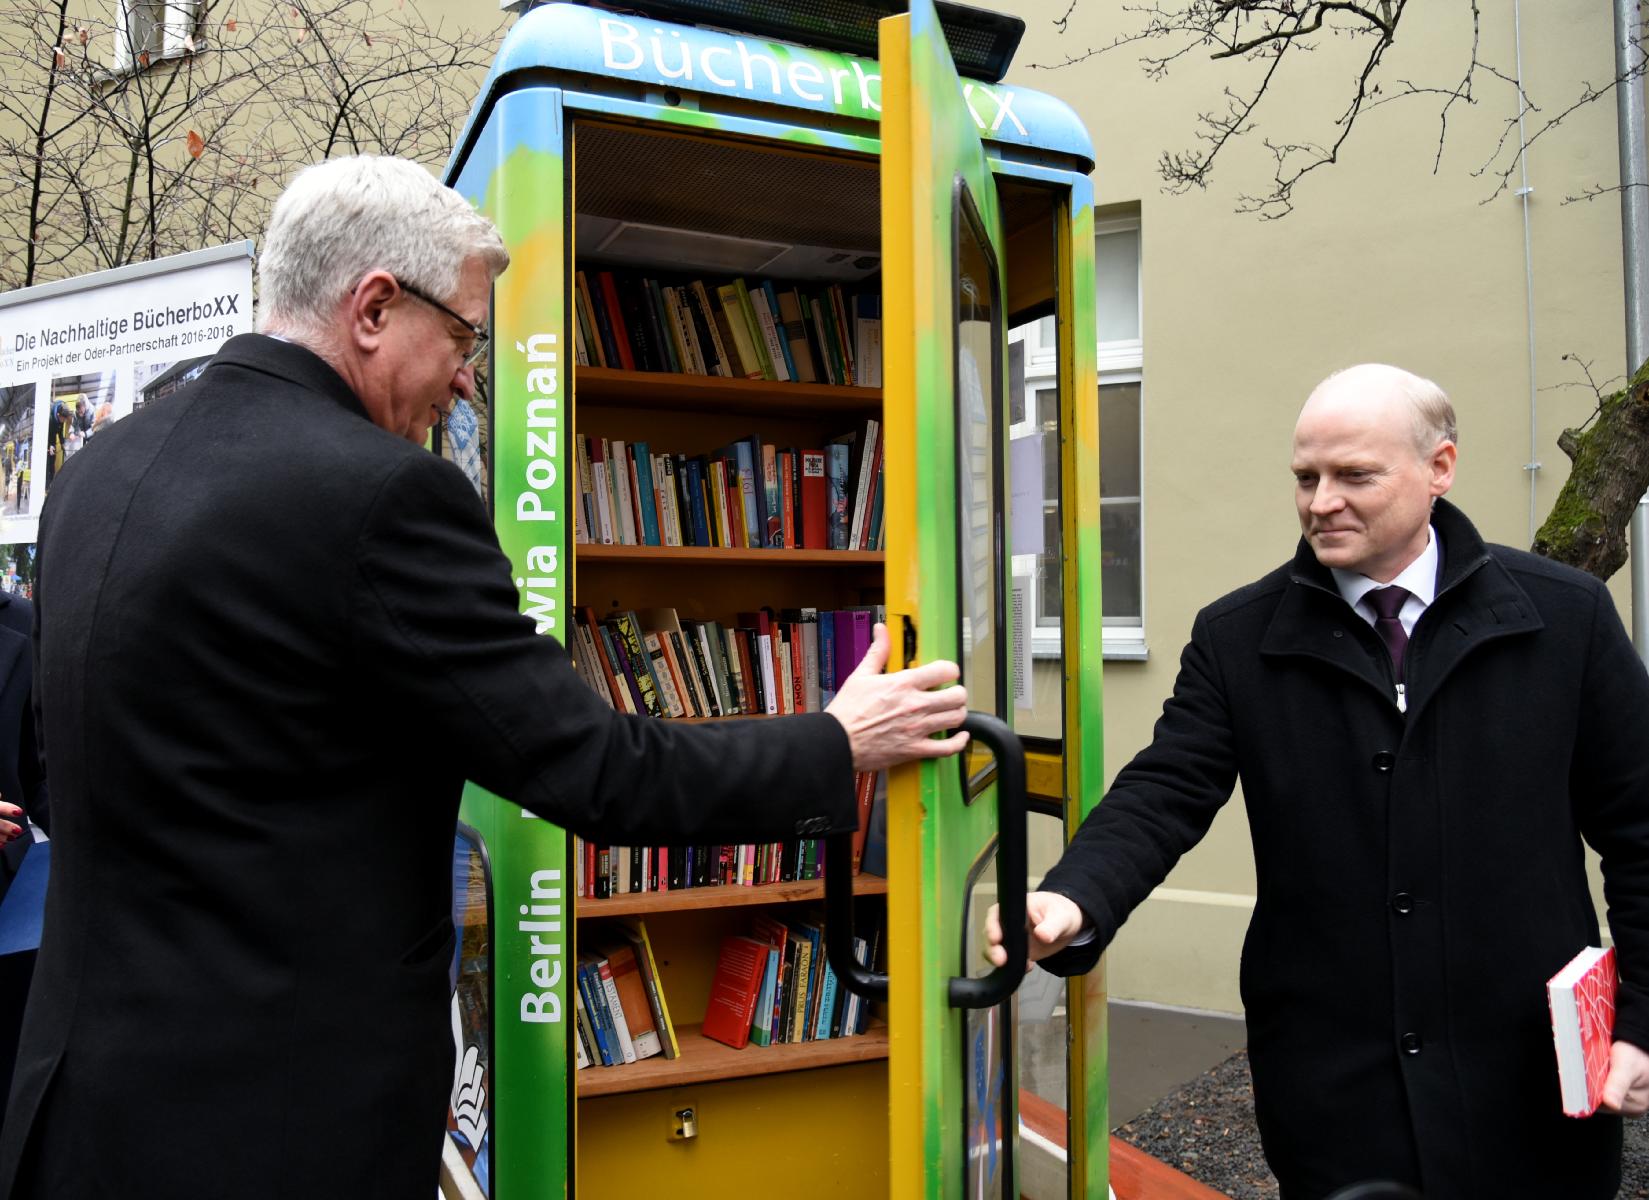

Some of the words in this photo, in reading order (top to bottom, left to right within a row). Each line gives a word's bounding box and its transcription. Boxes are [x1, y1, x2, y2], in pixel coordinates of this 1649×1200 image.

[600, 20, 1029, 137] BücherbXX
[15, 332, 36, 353] Die
[40, 316, 128, 348] Nachhaltige
[133, 293, 239, 331] BücherboXX
[16, 359, 30, 372] Ein
[31, 353, 63, 370] Projekt
[65, 351, 81, 364] der
[84, 334, 179, 361] Oder-Partnerschaft
[181, 324, 234, 346] 2016-2018
[516, 333, 557, 521] Poznań
[793, 676, 803, 707] AMON
[518, 868, 562, 1024] Berlin
[799, 955, 810, 990] FARAON
[605, 979, 623, 1019] TESTAMENT
[796, 991, 806, 1014] PRUS
